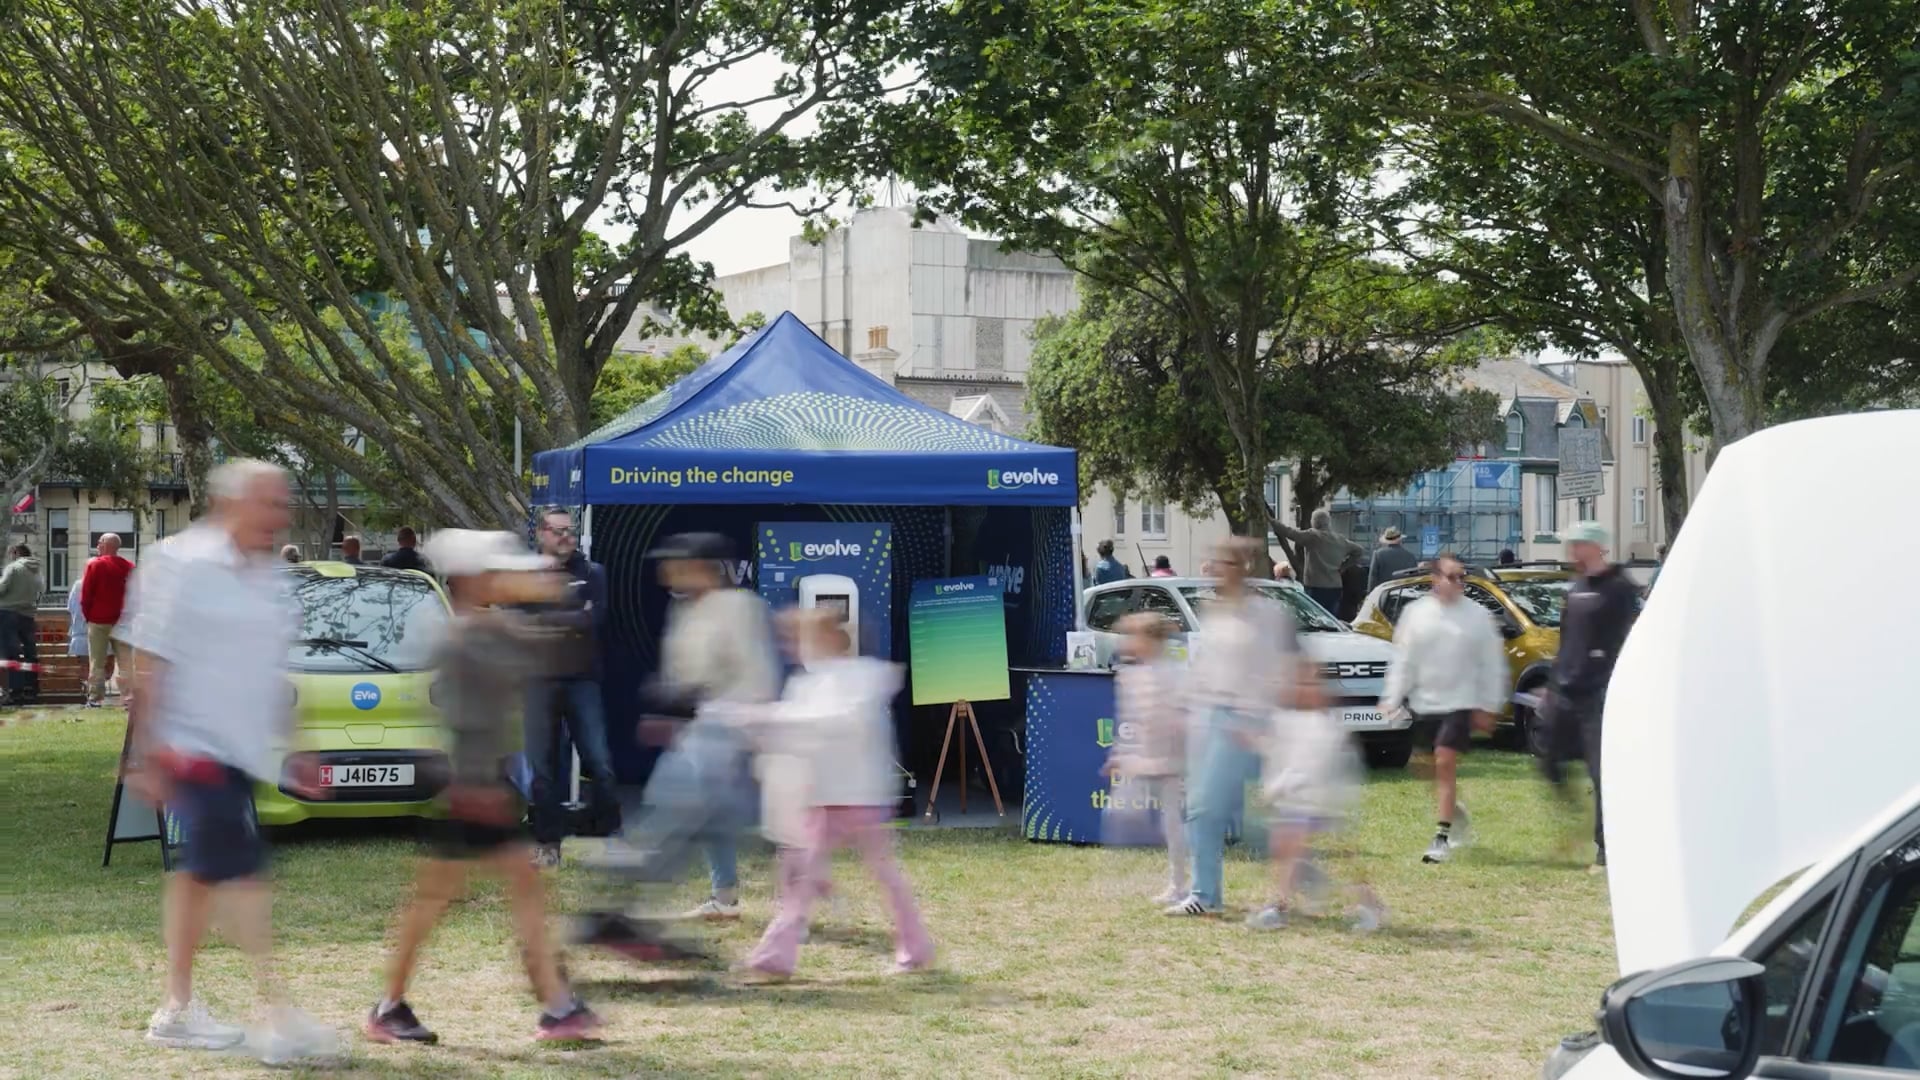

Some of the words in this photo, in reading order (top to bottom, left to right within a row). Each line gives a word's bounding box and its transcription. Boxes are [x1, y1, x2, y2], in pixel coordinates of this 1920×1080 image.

[610, 467, 681, 487] Driving
[687, 466, 718, 484] the
[721, 466, 794, 487] change
[1002, 467, 1058, 485] evolve
[804, 539, 861, 556] evolve
[943, 582, 975, 592] evolve
[1344, 712, 1383, 721] PRING
[340, 767, 399, 783] J41675
